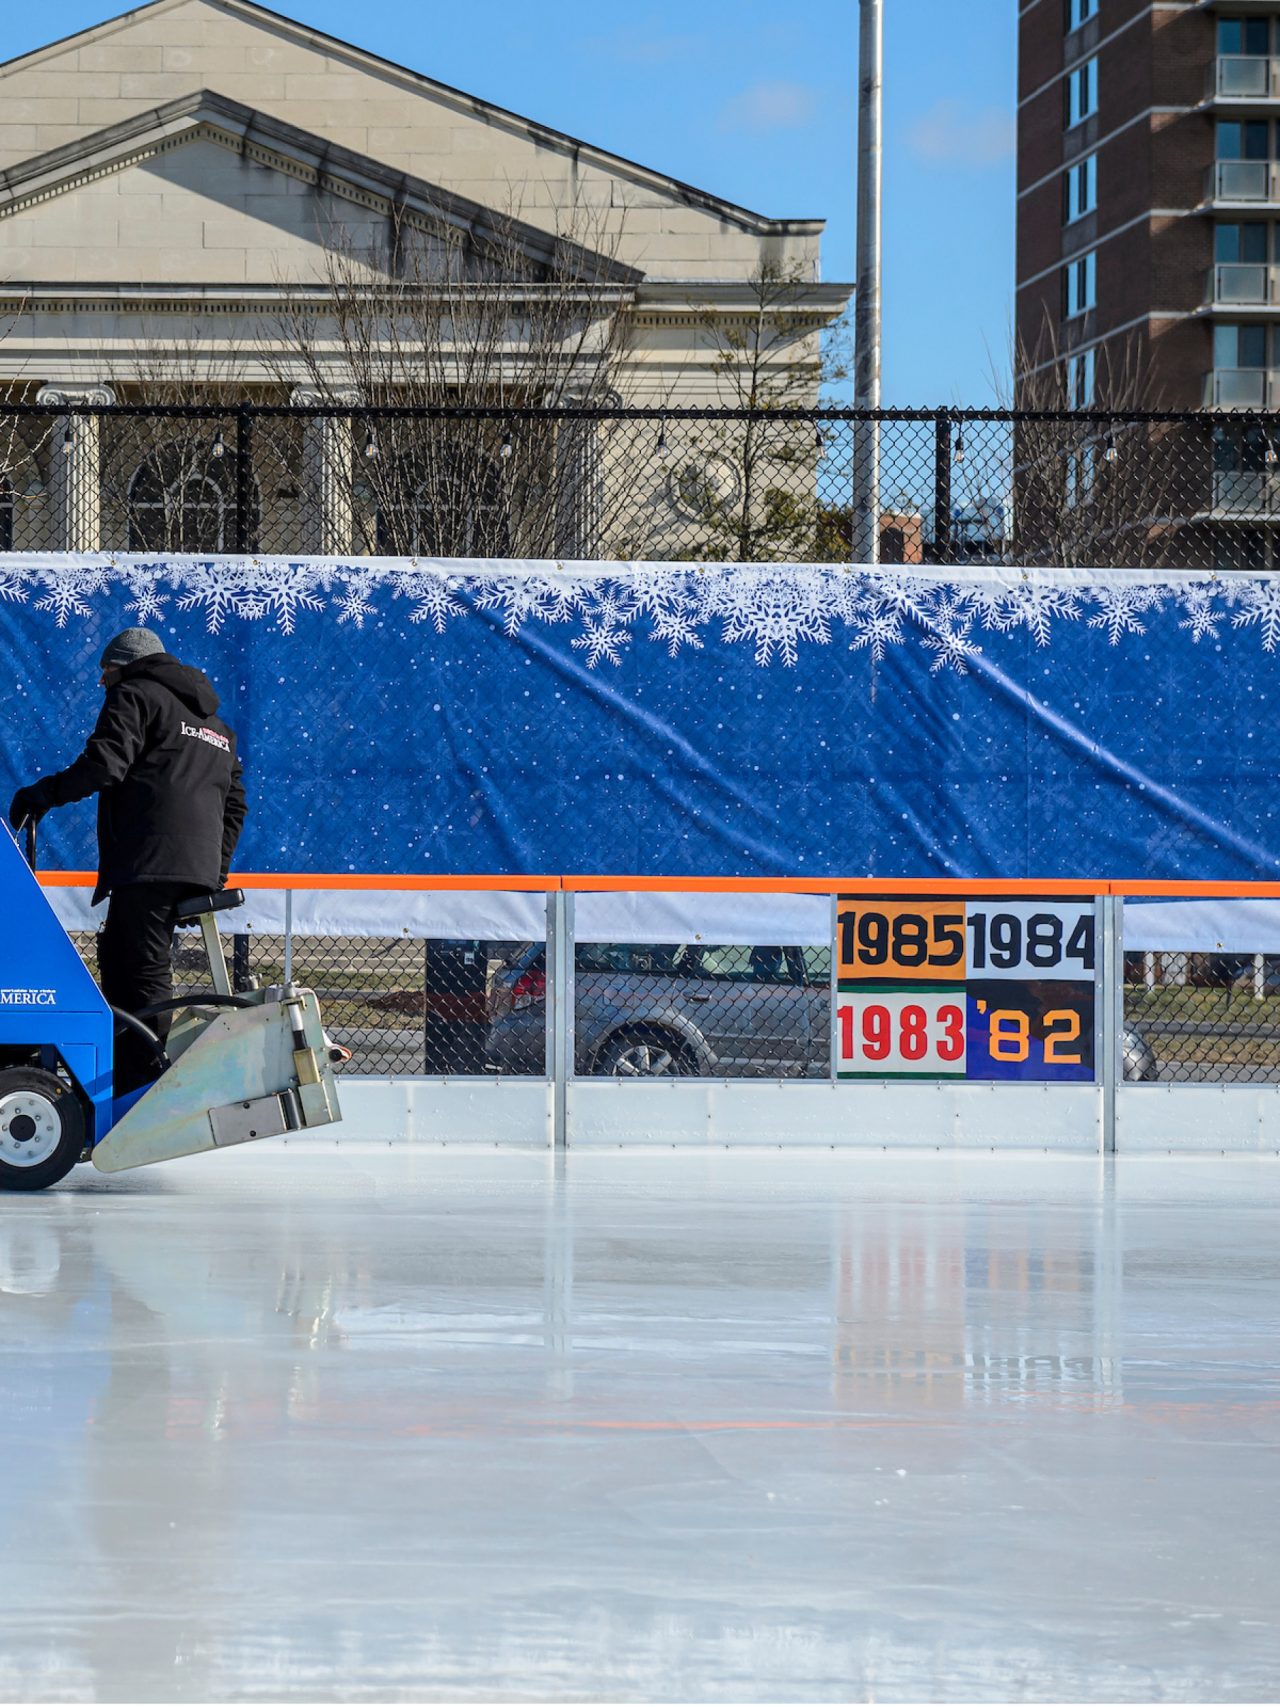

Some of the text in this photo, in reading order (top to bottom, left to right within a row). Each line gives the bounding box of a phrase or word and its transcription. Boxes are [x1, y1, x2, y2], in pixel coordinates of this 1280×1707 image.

[837, 911, 964, 967] 1985
[967, 913, 1095, 969] 1984
[837, 1004, 964, 1061] 1983
[976, 999, 1081, 1064] '82
